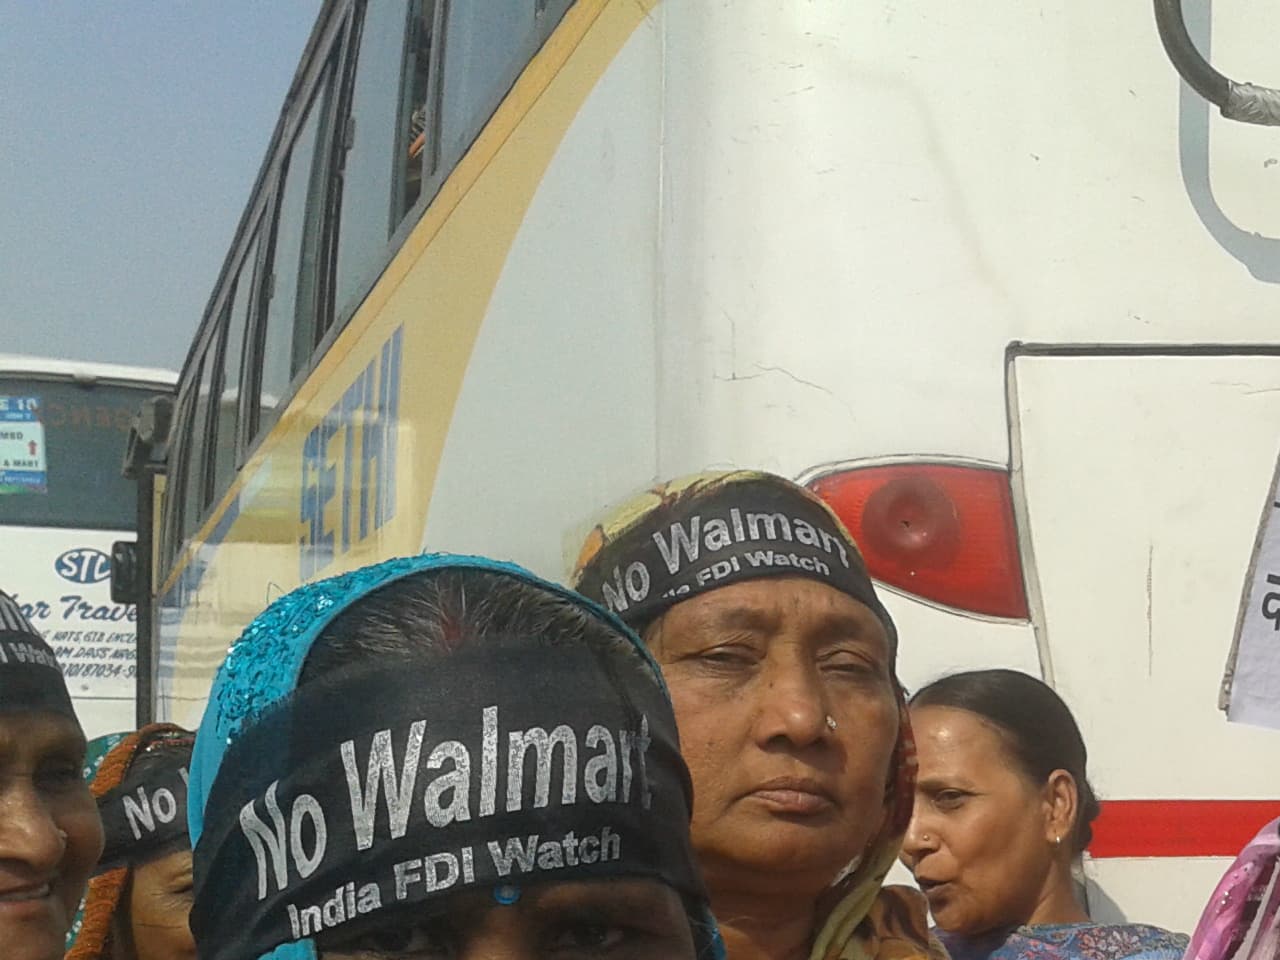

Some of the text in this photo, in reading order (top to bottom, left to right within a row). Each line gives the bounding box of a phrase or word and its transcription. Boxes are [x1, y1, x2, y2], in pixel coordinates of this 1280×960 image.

[602, 561, 650, 612] No
[696, 551, 830, 586] FDI Watch
[122, 786, 176, 840] No
[240, 780, 327, 900] No
[287, 826, 621, 940] India FDI Watch
